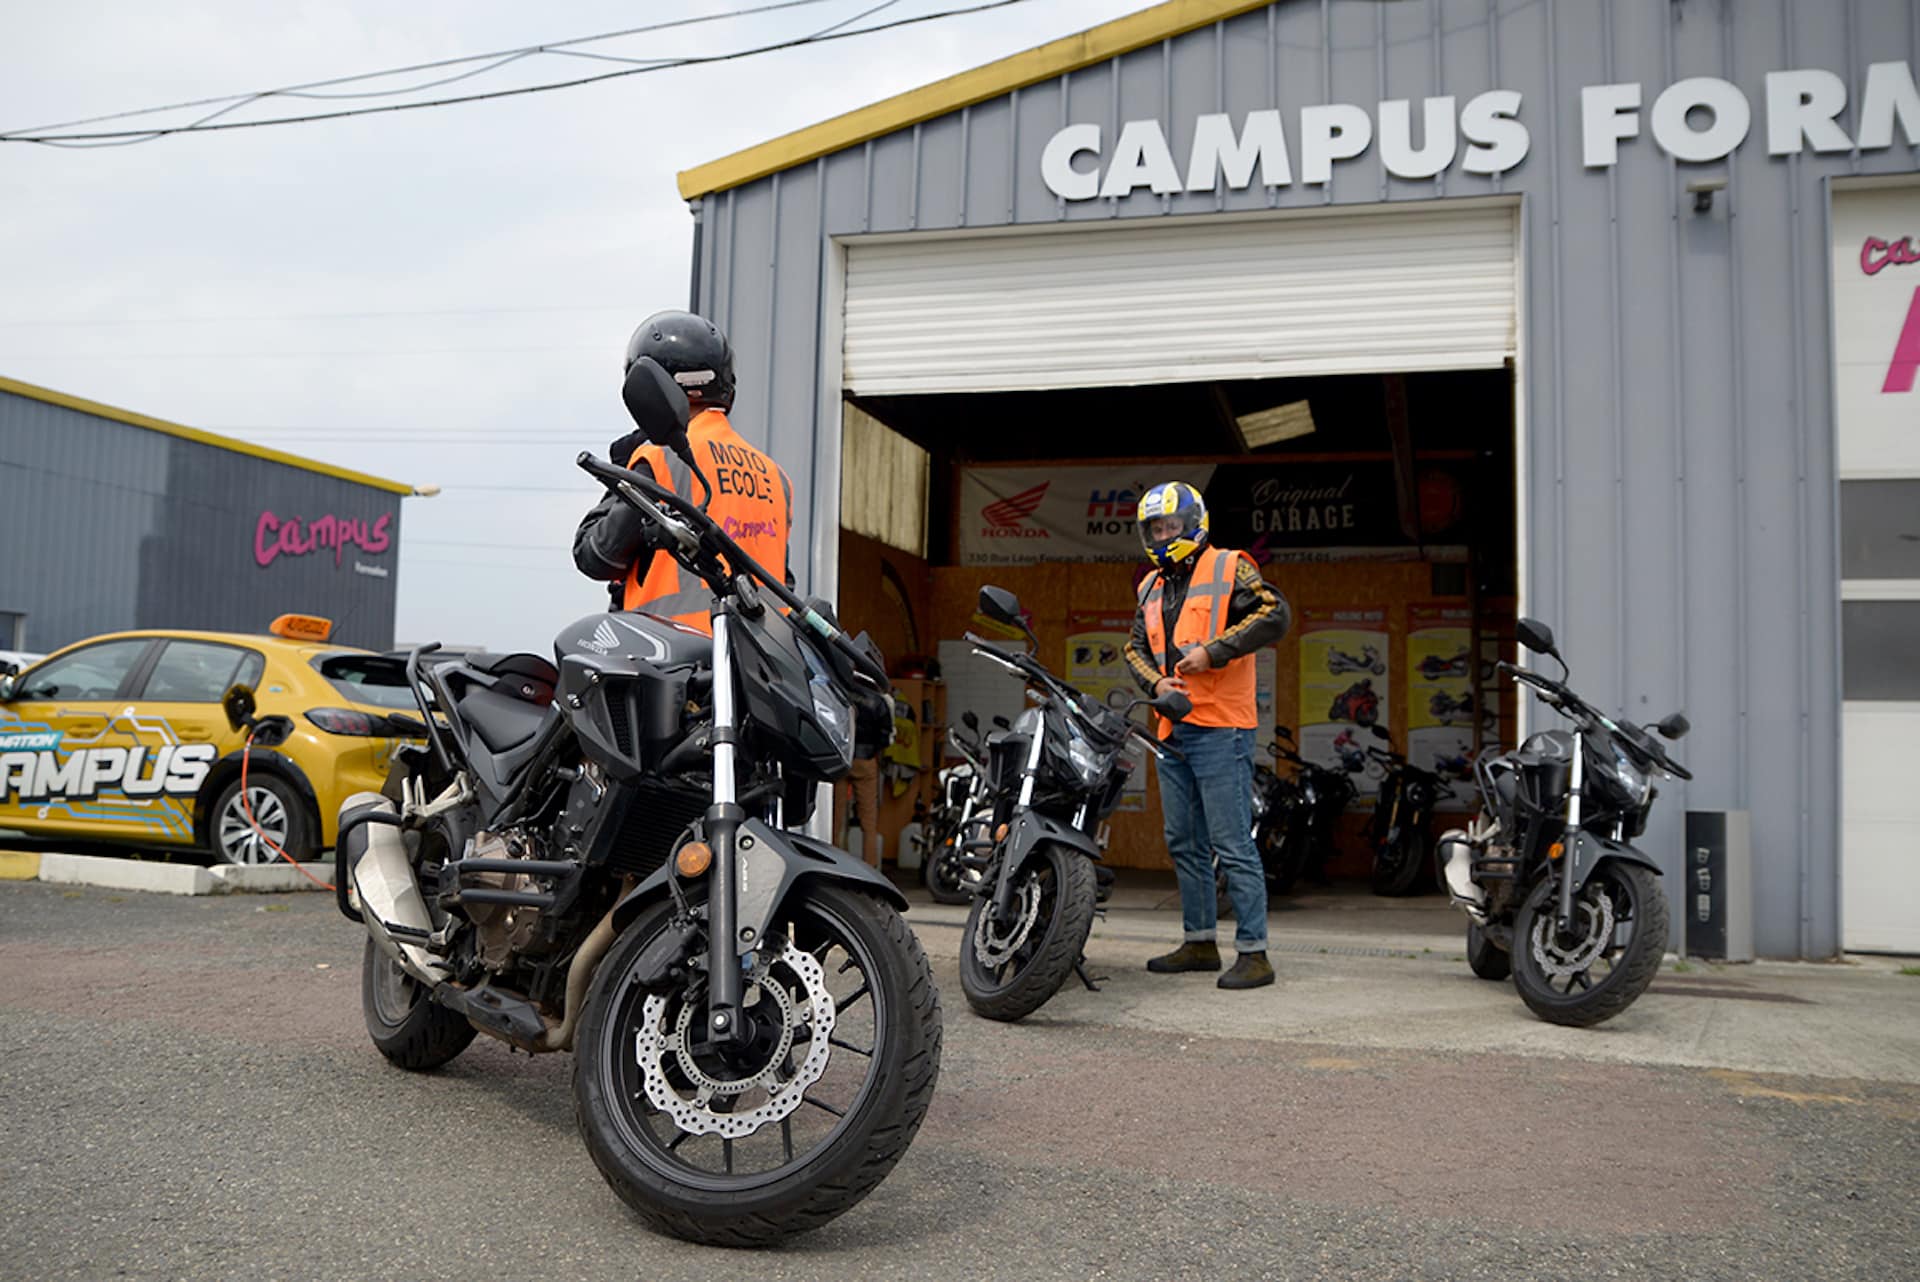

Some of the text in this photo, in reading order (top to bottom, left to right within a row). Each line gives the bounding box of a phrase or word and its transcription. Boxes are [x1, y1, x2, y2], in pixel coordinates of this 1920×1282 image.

[1041, 89, 1531, 201] CAMPUS
[708, 439, 767, 475] MOTO
[1251, 474, 1353, 507] Original
[981, 527, 1050, 538] HONDA
[1087, 521, 1136, 535] MOT
[1251, 504, 1355, 532] GARAGE
[254, 510, 393, 567] Campus
[576, 638, 609, 656] HONDA
